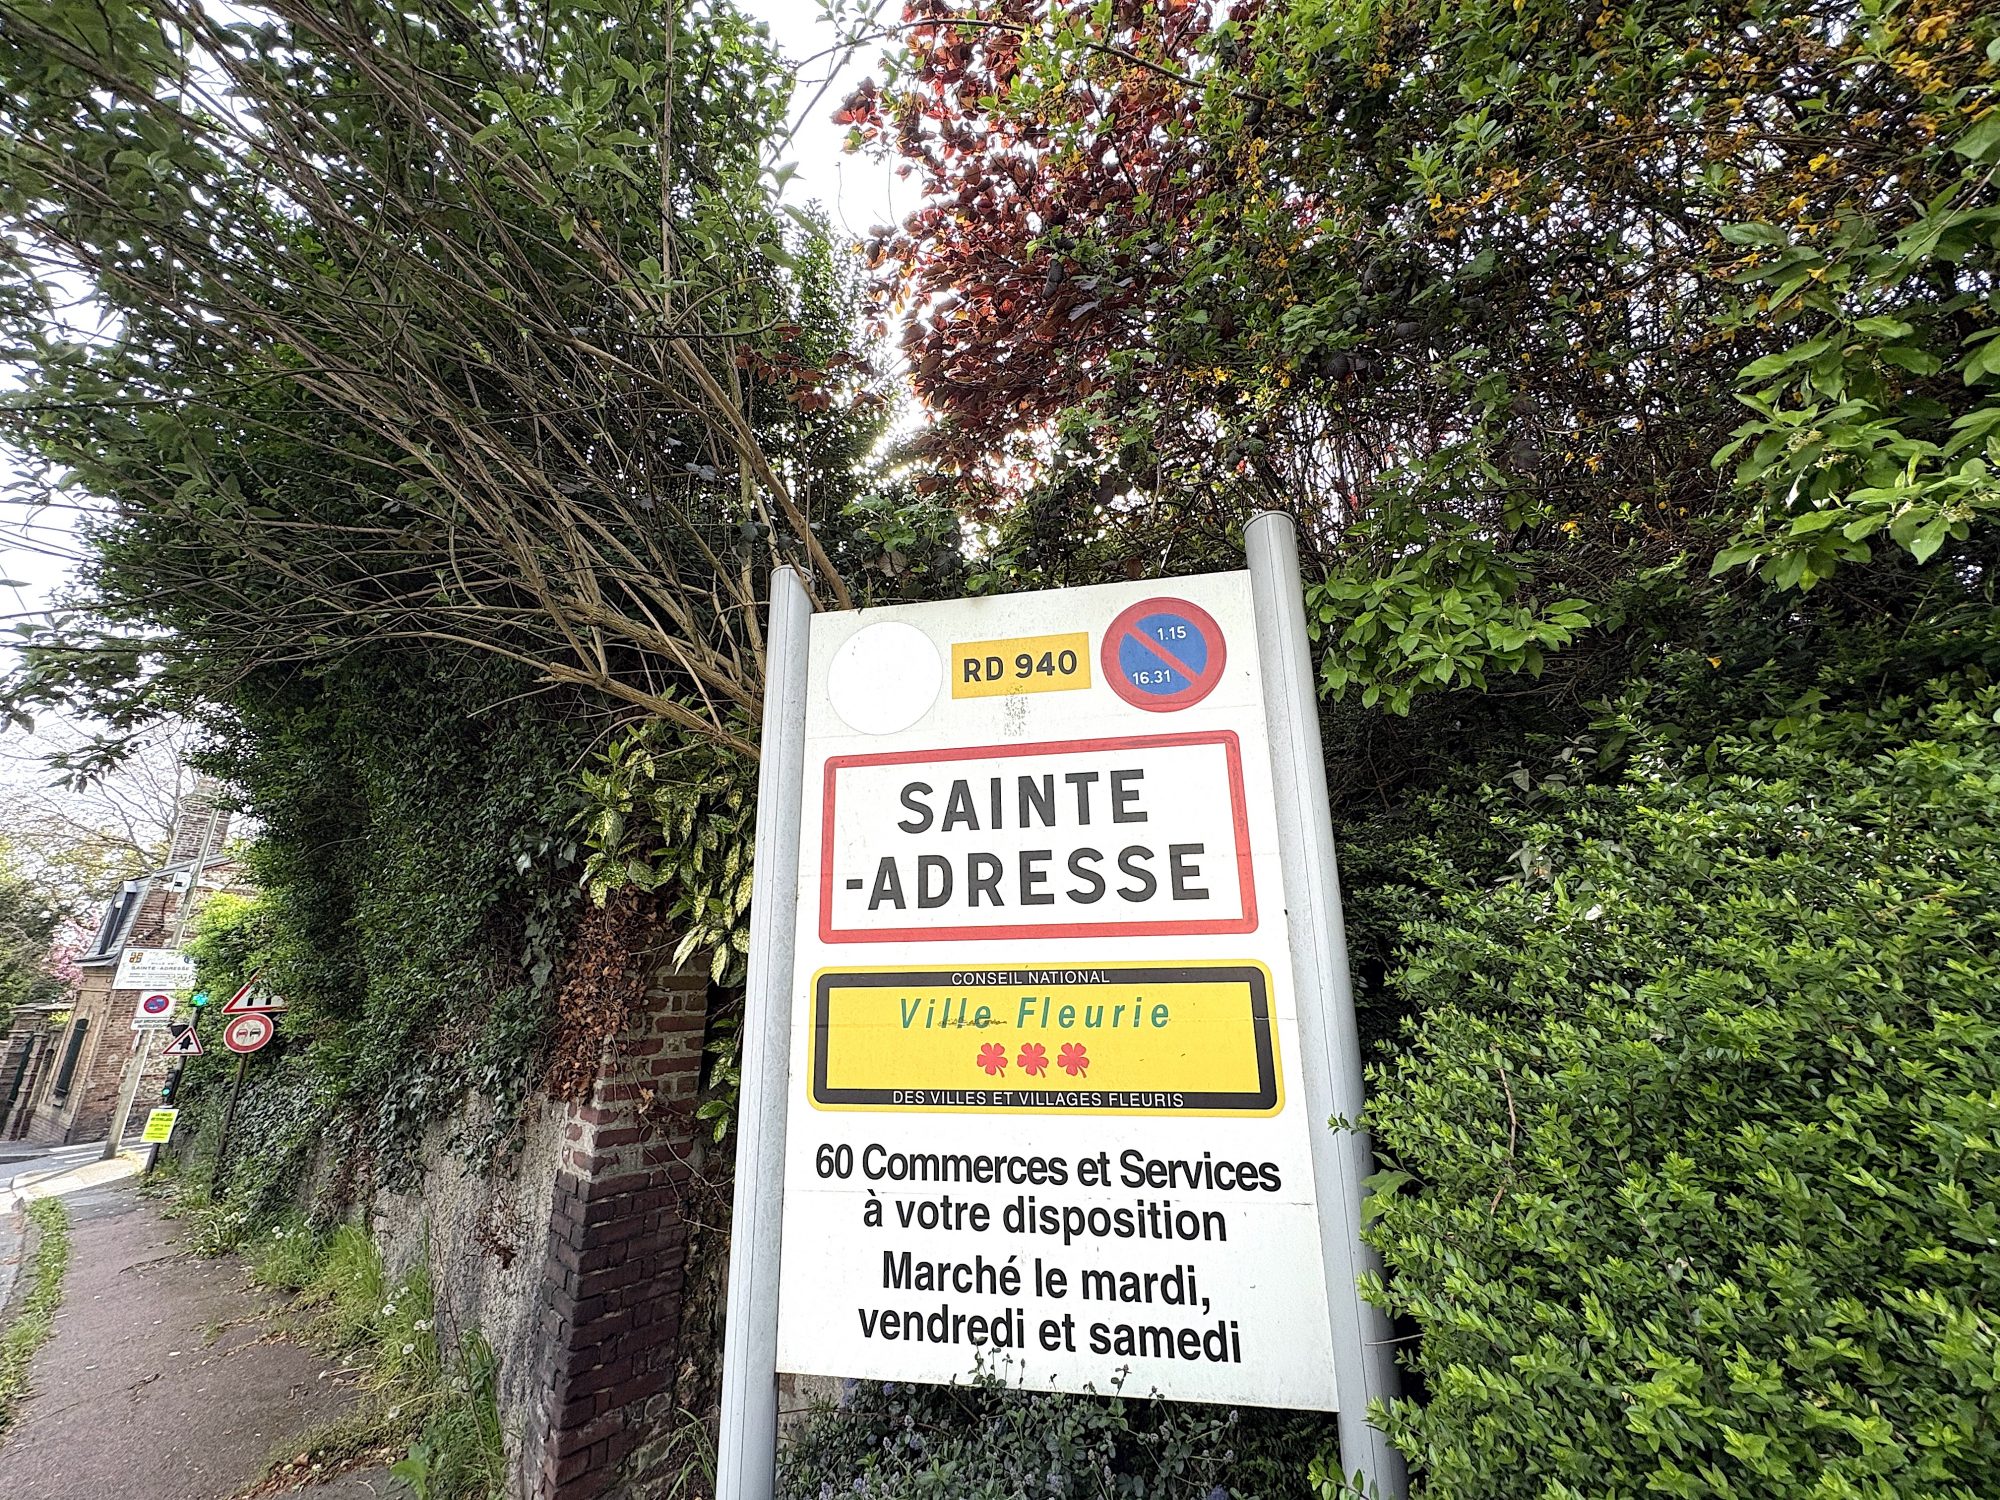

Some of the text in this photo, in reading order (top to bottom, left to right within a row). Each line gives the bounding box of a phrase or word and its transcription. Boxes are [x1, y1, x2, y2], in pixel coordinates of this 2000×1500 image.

[1157, 625, 1187, 642] 1.15
[963, 649, 1078, 683] RD 940
[1132, 669, 1171, 686] 16.31
[897, 769, 1148, 834] SAINTE
[846, 843, 1210, 911] -ADRESSE
[952, 970, 1110, 984] CONSEIL NATIONAL
[899, 996, 1171, 1029] Ville Fleurie
[893, 1091, 1184, 1108] DES VILLES ET VILLAGES FLEURIS
[815, 1144, 1281, 1191] 60 Commerces et Services
[863, 1191, 1227, 1245] à votre disposition
[883, 1250, 1211, 1314] Marché le mardi,
[858, 1304, 1242, 1364] vendredi et samedi
